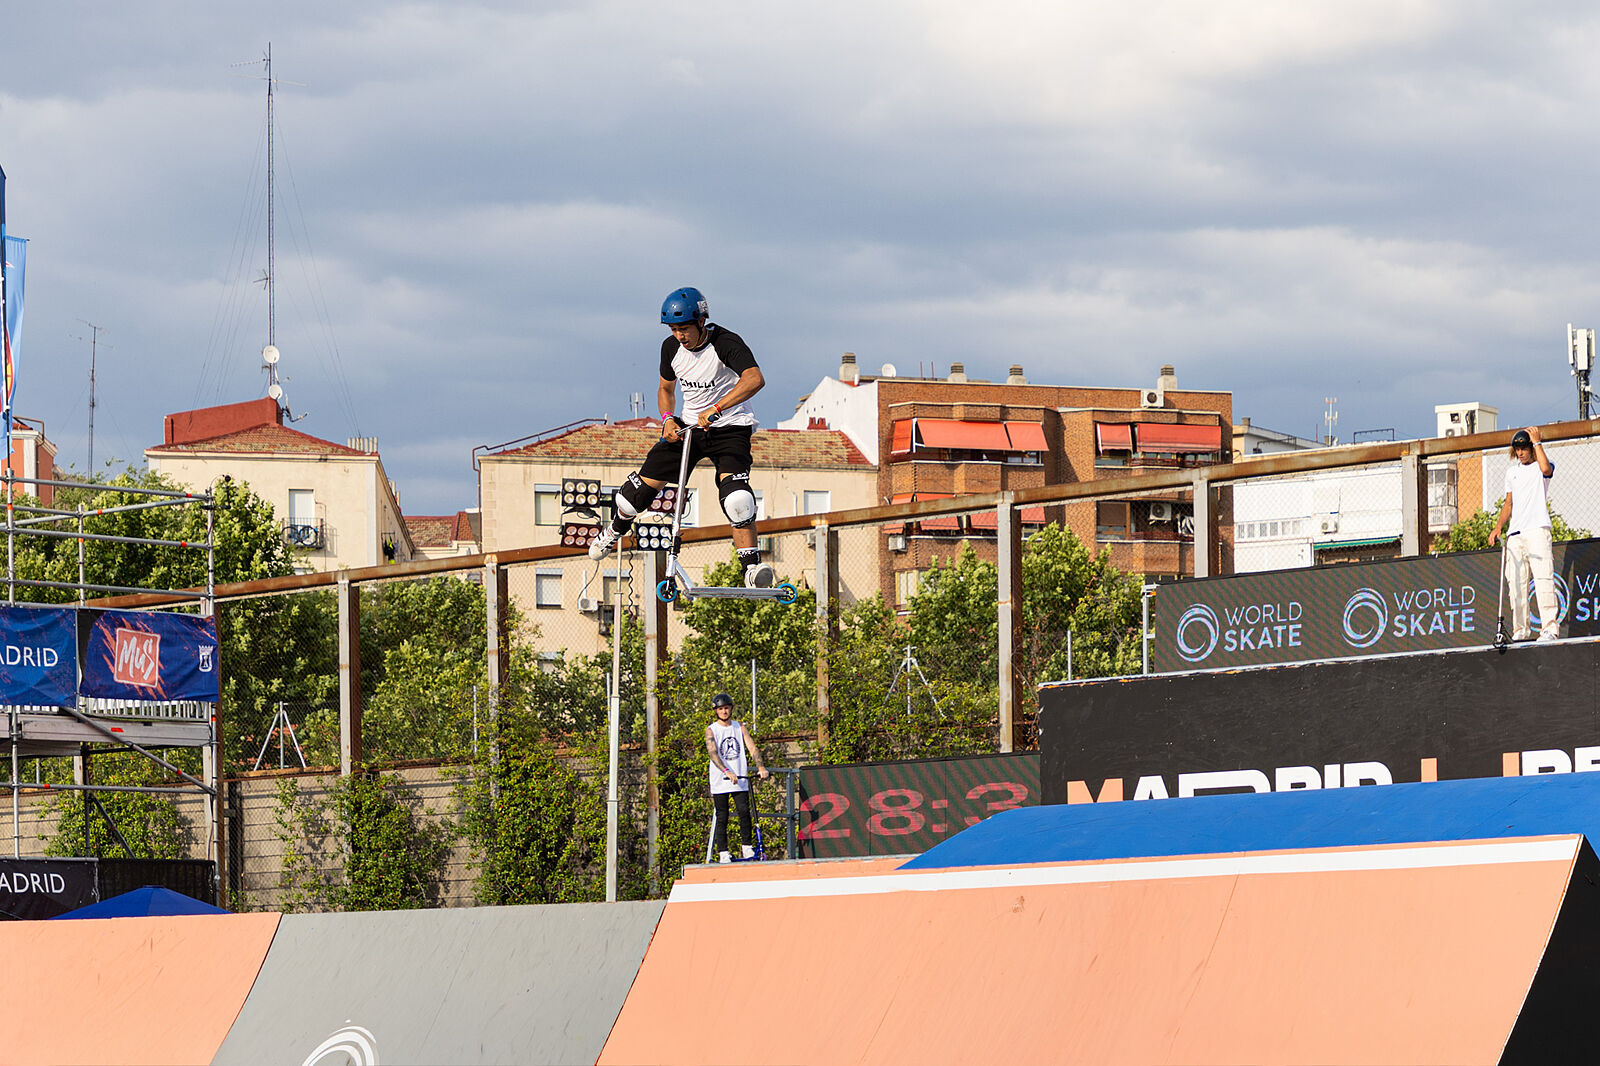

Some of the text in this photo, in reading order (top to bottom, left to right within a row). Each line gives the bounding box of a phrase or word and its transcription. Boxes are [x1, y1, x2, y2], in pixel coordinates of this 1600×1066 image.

[1394, 586, 1476, 611] WORLD
[1225, 602, 1303, 627] WORLD
[1393, 608, 1475, 638] SKATE
[1224, 623, 1302, 652] SKATE
[0, 645, 58, 667] DRID
